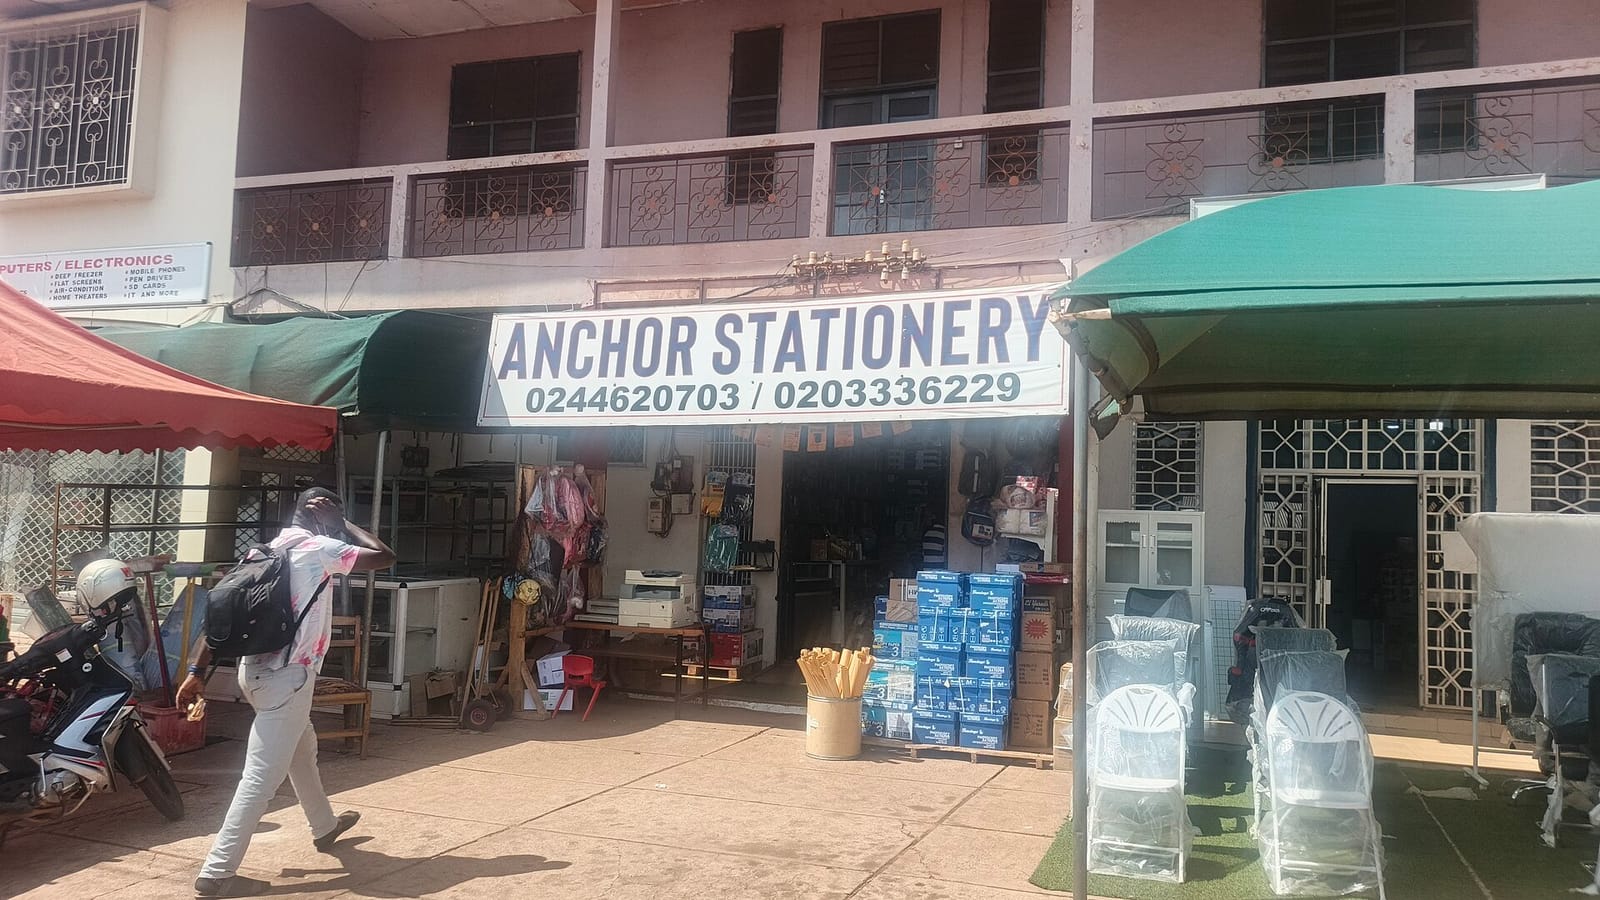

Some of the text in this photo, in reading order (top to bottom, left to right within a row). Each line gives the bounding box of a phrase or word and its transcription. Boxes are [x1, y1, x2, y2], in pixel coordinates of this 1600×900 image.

[55, 261, 60, 271] /
[65, 254, 173, 270] ELECTRONICS
[74, 271, 103, 279] FREEZER
[130, 265, 186, 275] MOBILE PHONES
[72, 278, 102, 286] SCREENS
[146, 274, 173, 282] DRIVES
[140, 290, 155, 298] AND
[498, 293, 1050, 380] ANCHOR STATIONERY
[525, 372, 1021, 413] 0244620703 / 0203336229
[891, 646, 899, 657] 3
[877, 687, 885, 698] 3
[875, 725, 883, 736] 3
